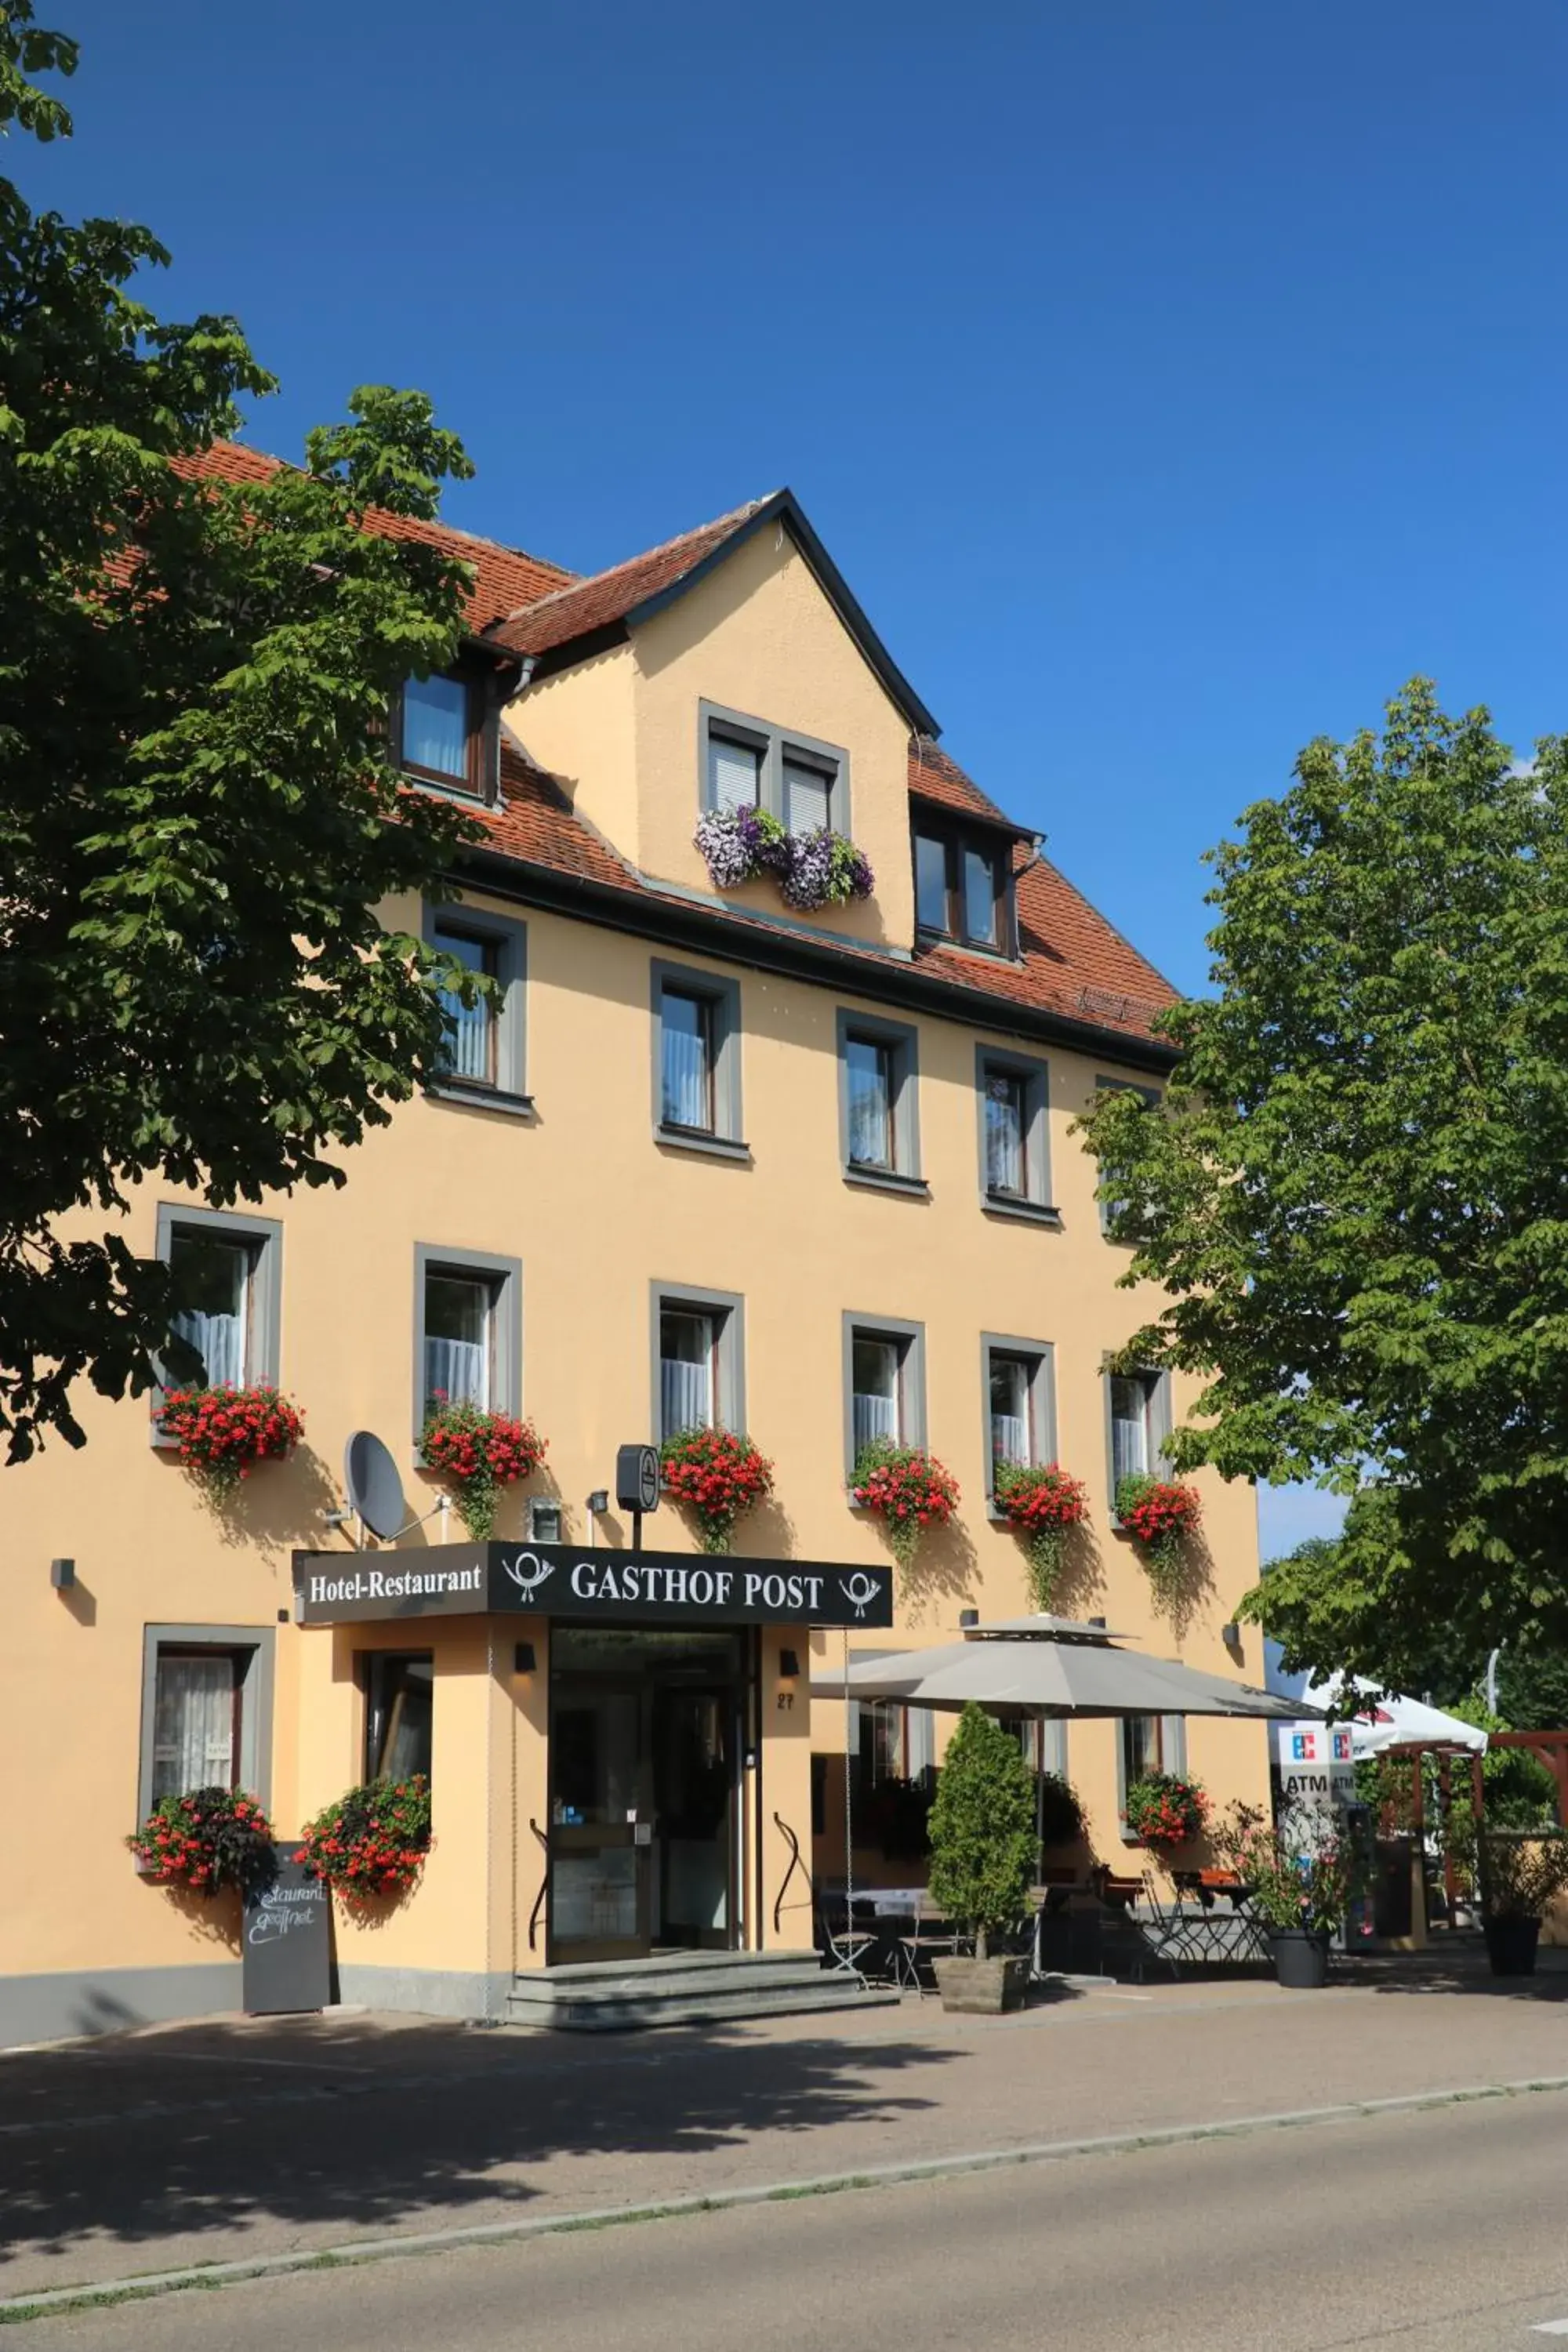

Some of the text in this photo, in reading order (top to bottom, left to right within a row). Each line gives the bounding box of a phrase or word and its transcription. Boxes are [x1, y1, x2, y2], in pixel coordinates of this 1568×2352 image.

[310, 1563, 482, 1603] Hotel-Restaurant
[571, 1563, 824, 1610] GASTHOF POST
[777, 1693, 794, 1710] 27
[1287, 1775, 1327, 1794] ATM
[1333, 1775, 1355, 1791] ATM
